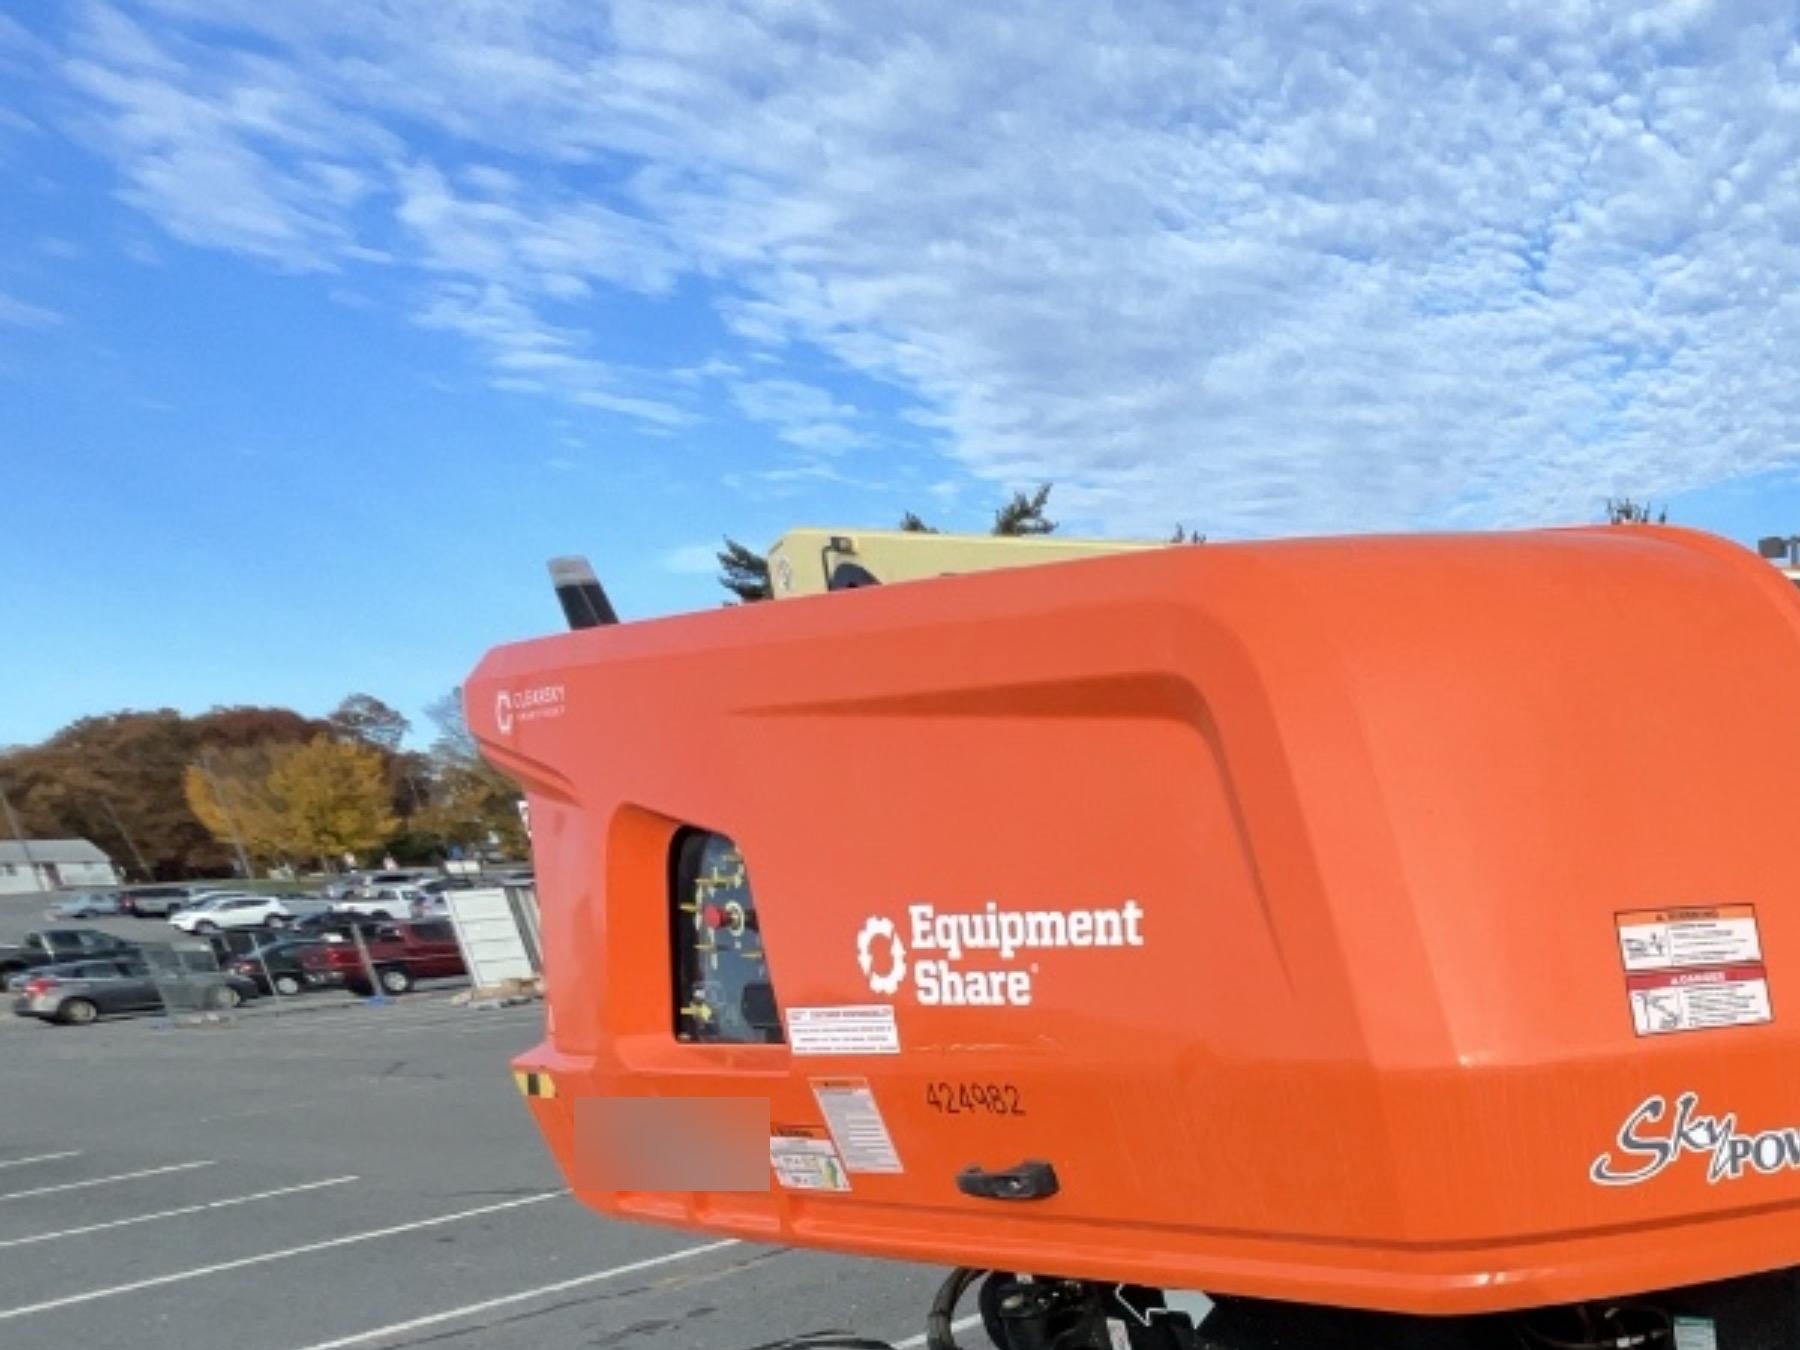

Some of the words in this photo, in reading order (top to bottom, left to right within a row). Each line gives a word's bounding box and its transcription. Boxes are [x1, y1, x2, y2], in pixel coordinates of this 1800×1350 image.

[908, 899, 1144, 960] Equipment
[914, 959, 1032, 1006] Share
[926, 1082, 1026, 1117] 424982
